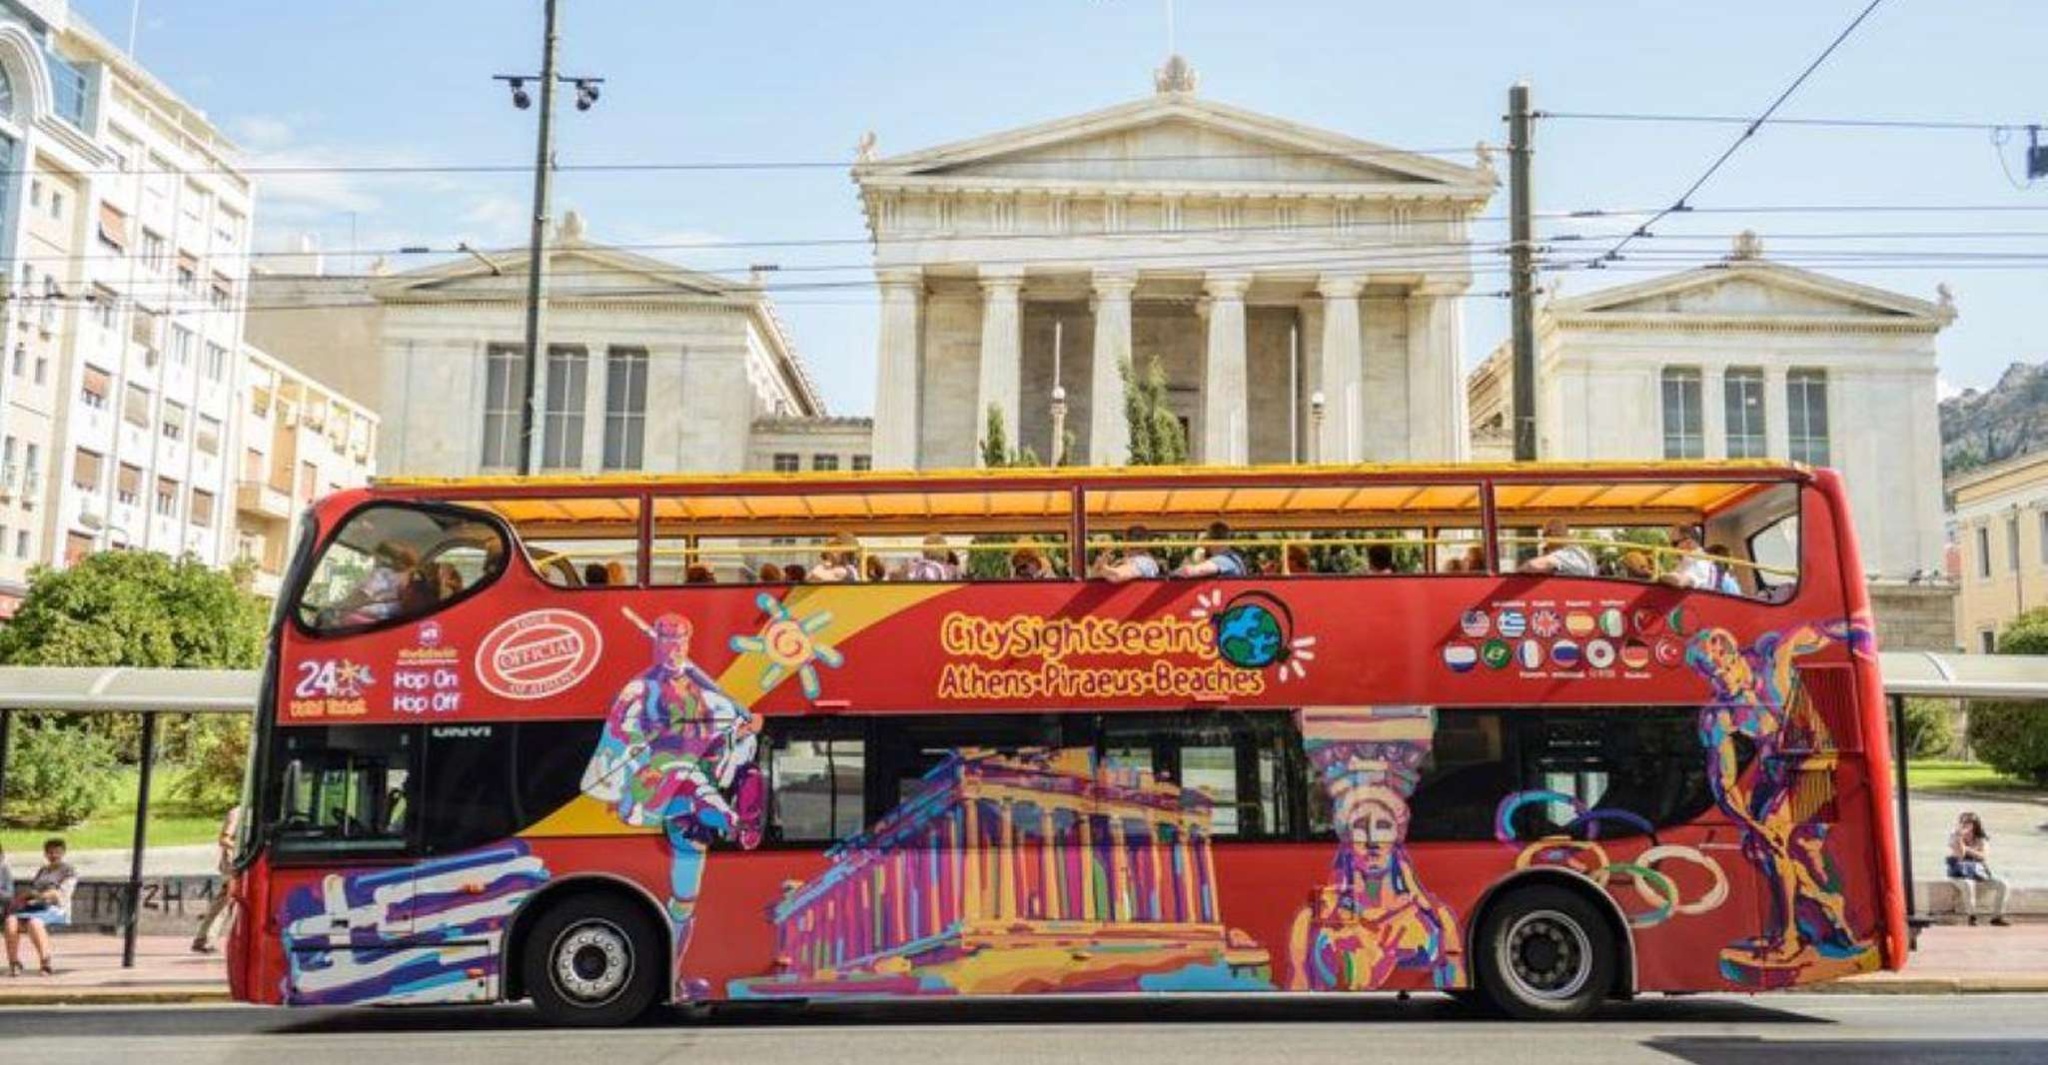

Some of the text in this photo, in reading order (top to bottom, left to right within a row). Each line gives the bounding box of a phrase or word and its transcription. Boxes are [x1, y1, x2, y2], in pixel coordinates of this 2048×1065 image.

[941, 611, 1219, 658] CitySightseeing
[498, 635, 579, 668] OFFICIAL
[393, 669, 459, 691] Hop On
[392, 692, 461, 714] Hop Off
